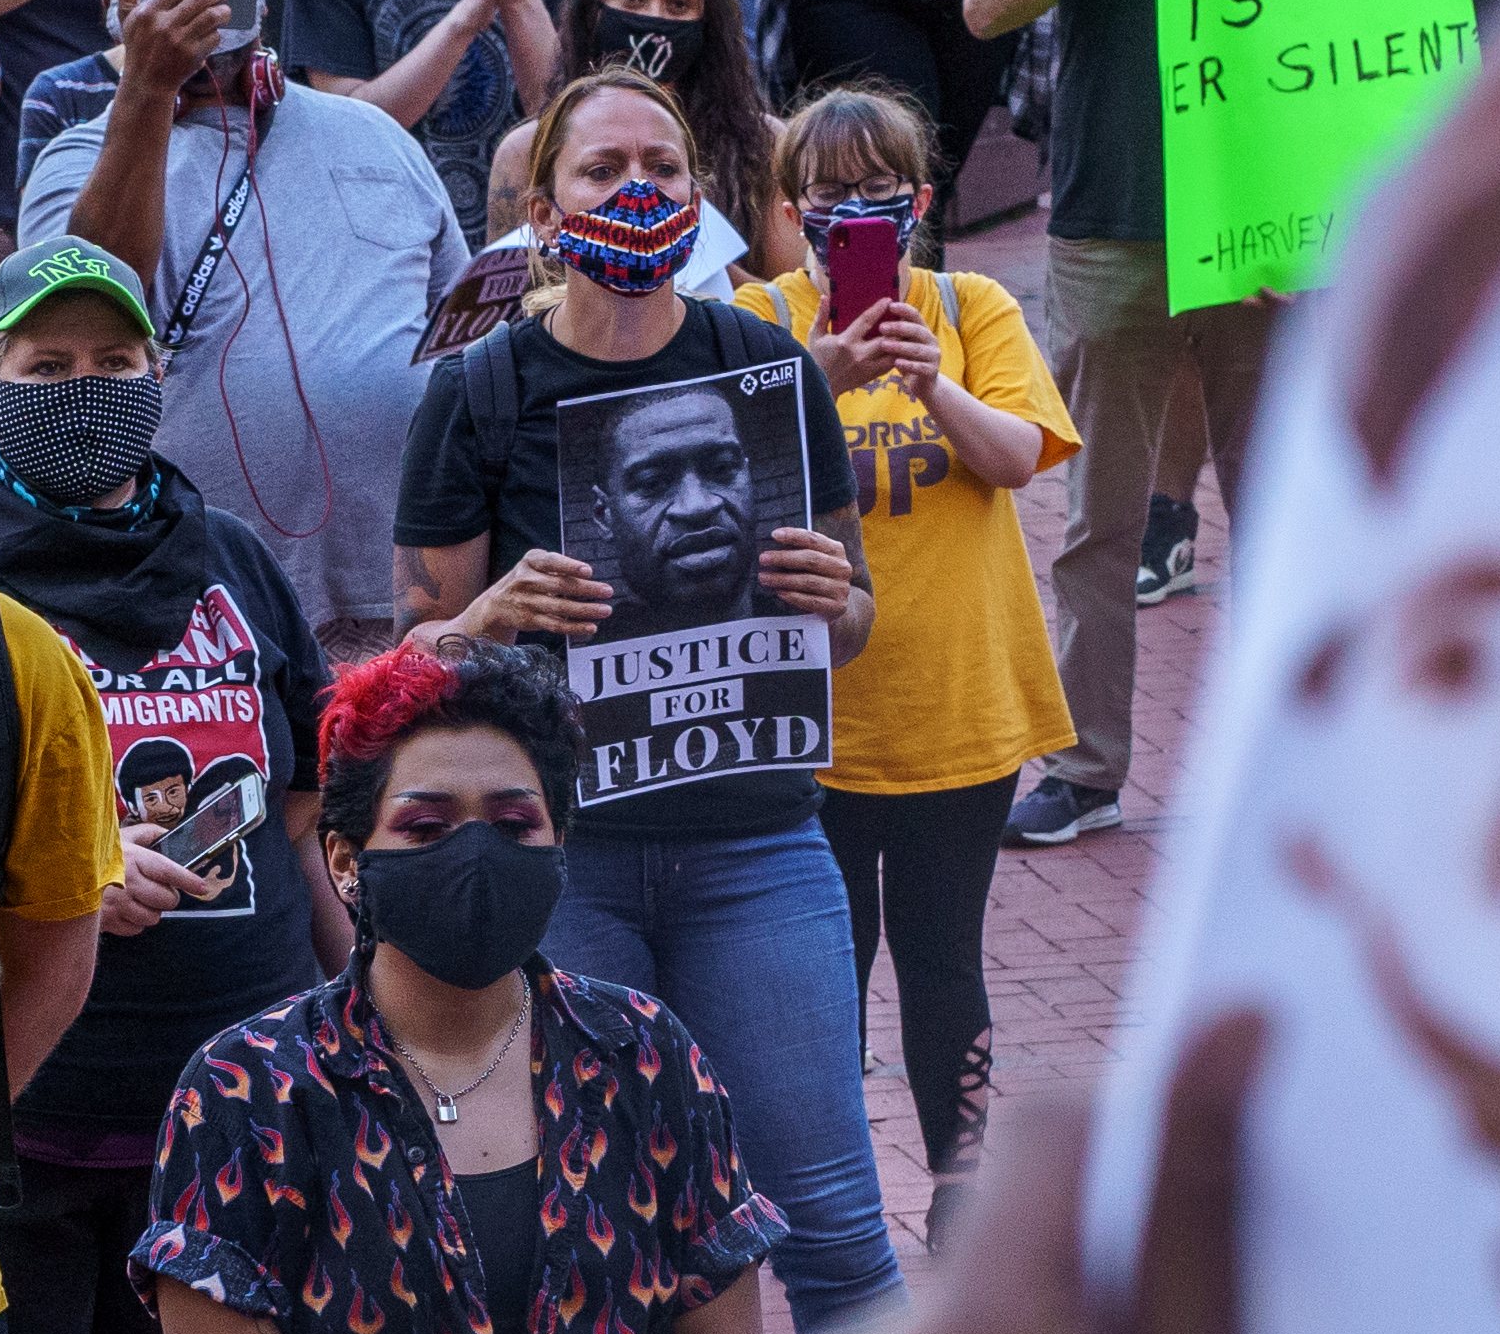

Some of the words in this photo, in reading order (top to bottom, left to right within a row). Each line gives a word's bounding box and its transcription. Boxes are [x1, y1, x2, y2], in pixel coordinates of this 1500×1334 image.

[627, 32, 674, 79] XO
[223, 176, 251, 229] adidas
[181, 251, 215, 316] adidas
[759, 364, 795, 386] CAIR
[846, 415, 947, 449] ORNS
[858, 442, 950, 518] UP
[94, 666, 148, 695] OR
[160, 659, 250, 695] ALL
[590, 626, 806, 701] JUSTICE
[100, 687, 257, 728] MIGRANTS
[663, 685, 732, 719] FOR
[592, 714, 821, 793] FLOYD
